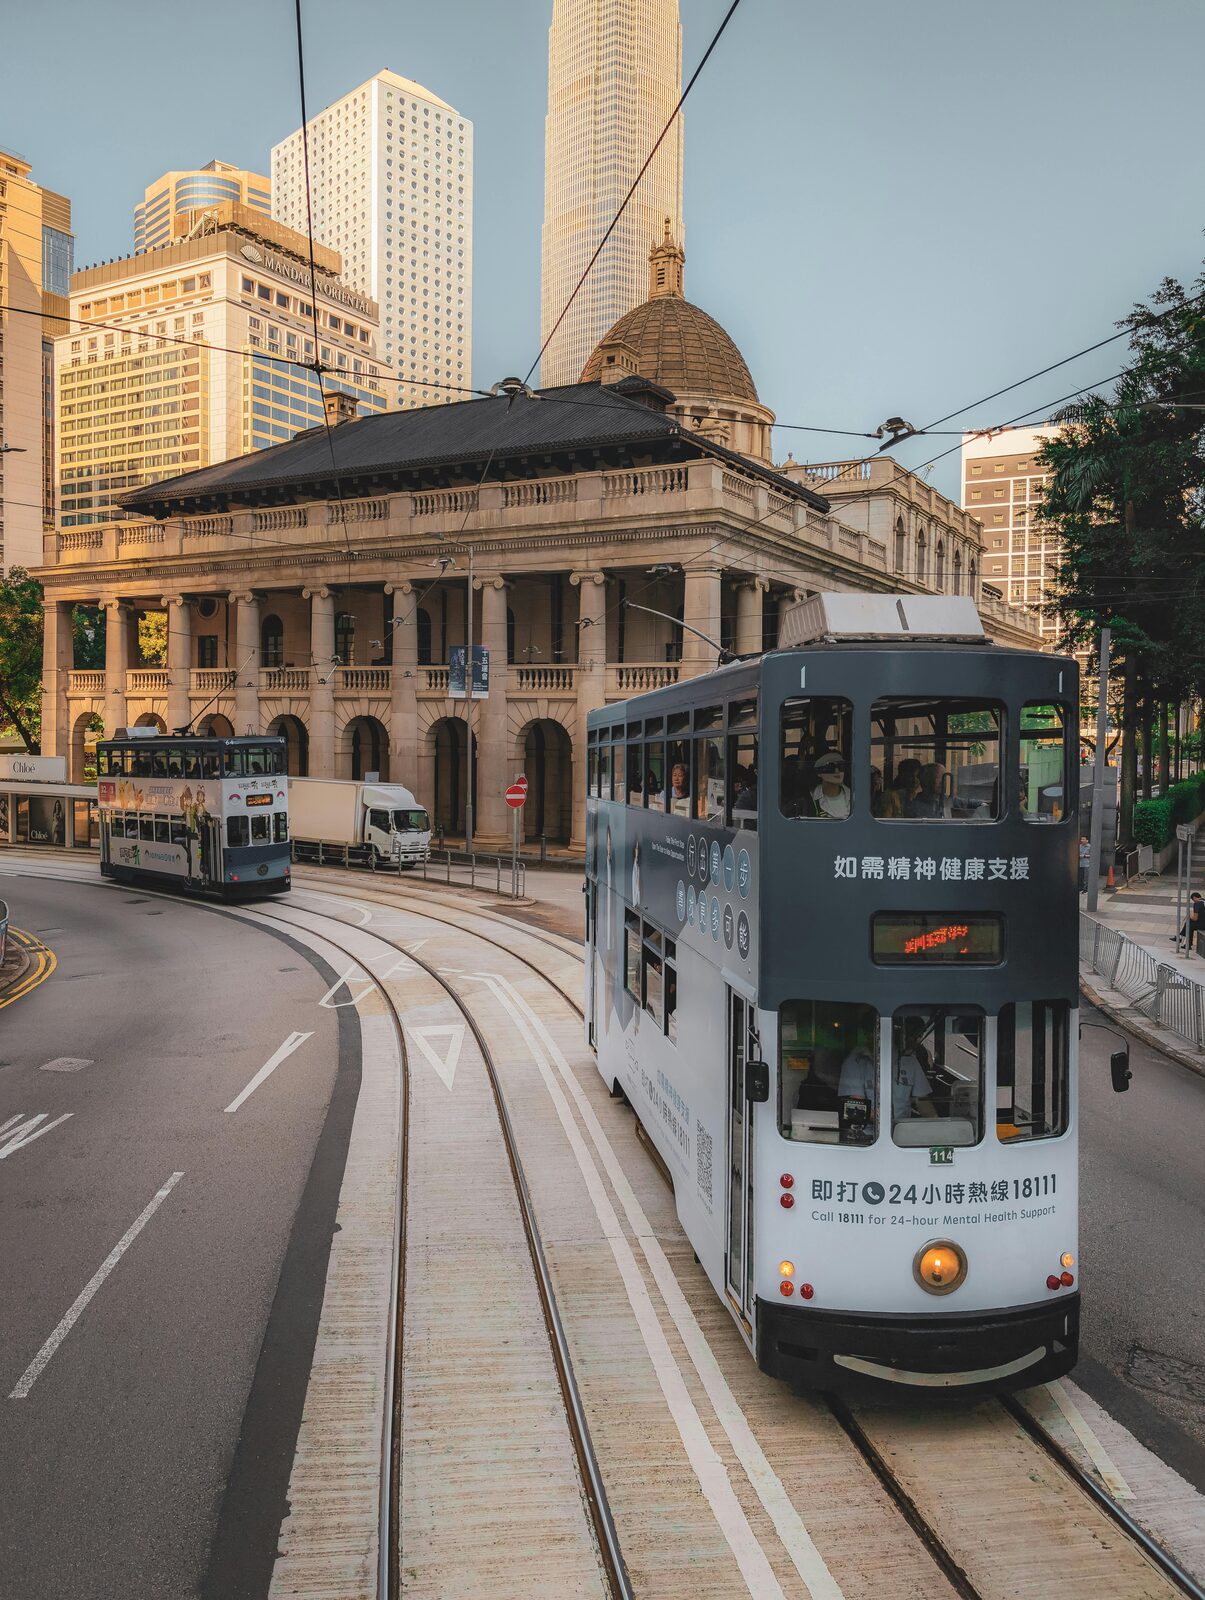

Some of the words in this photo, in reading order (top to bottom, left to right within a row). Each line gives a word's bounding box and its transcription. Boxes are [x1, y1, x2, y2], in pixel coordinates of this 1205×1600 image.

[264, 255, 322, 292] MANDARN
[324, 283, 371, 316] ORIENTAL
[12, 761, 36, 774] Chloé
[30, 830, 48, 840] Chloé
[833, 855, 1030, 881] 如需精神健康支援
[932, 1150, 953, 1162] 114
[811, 1210, 834, 1222] Call
[838, 1212, 864, 1224] 18111
[868, 1214, 886, 1225] for
[891, 1215, 939, 1226] 24-hour
[942, 1213, 981, 1225] Mental
[984, 1209, 1018, 1223] Health
[1020, 1204, 1056, 1220] Support
